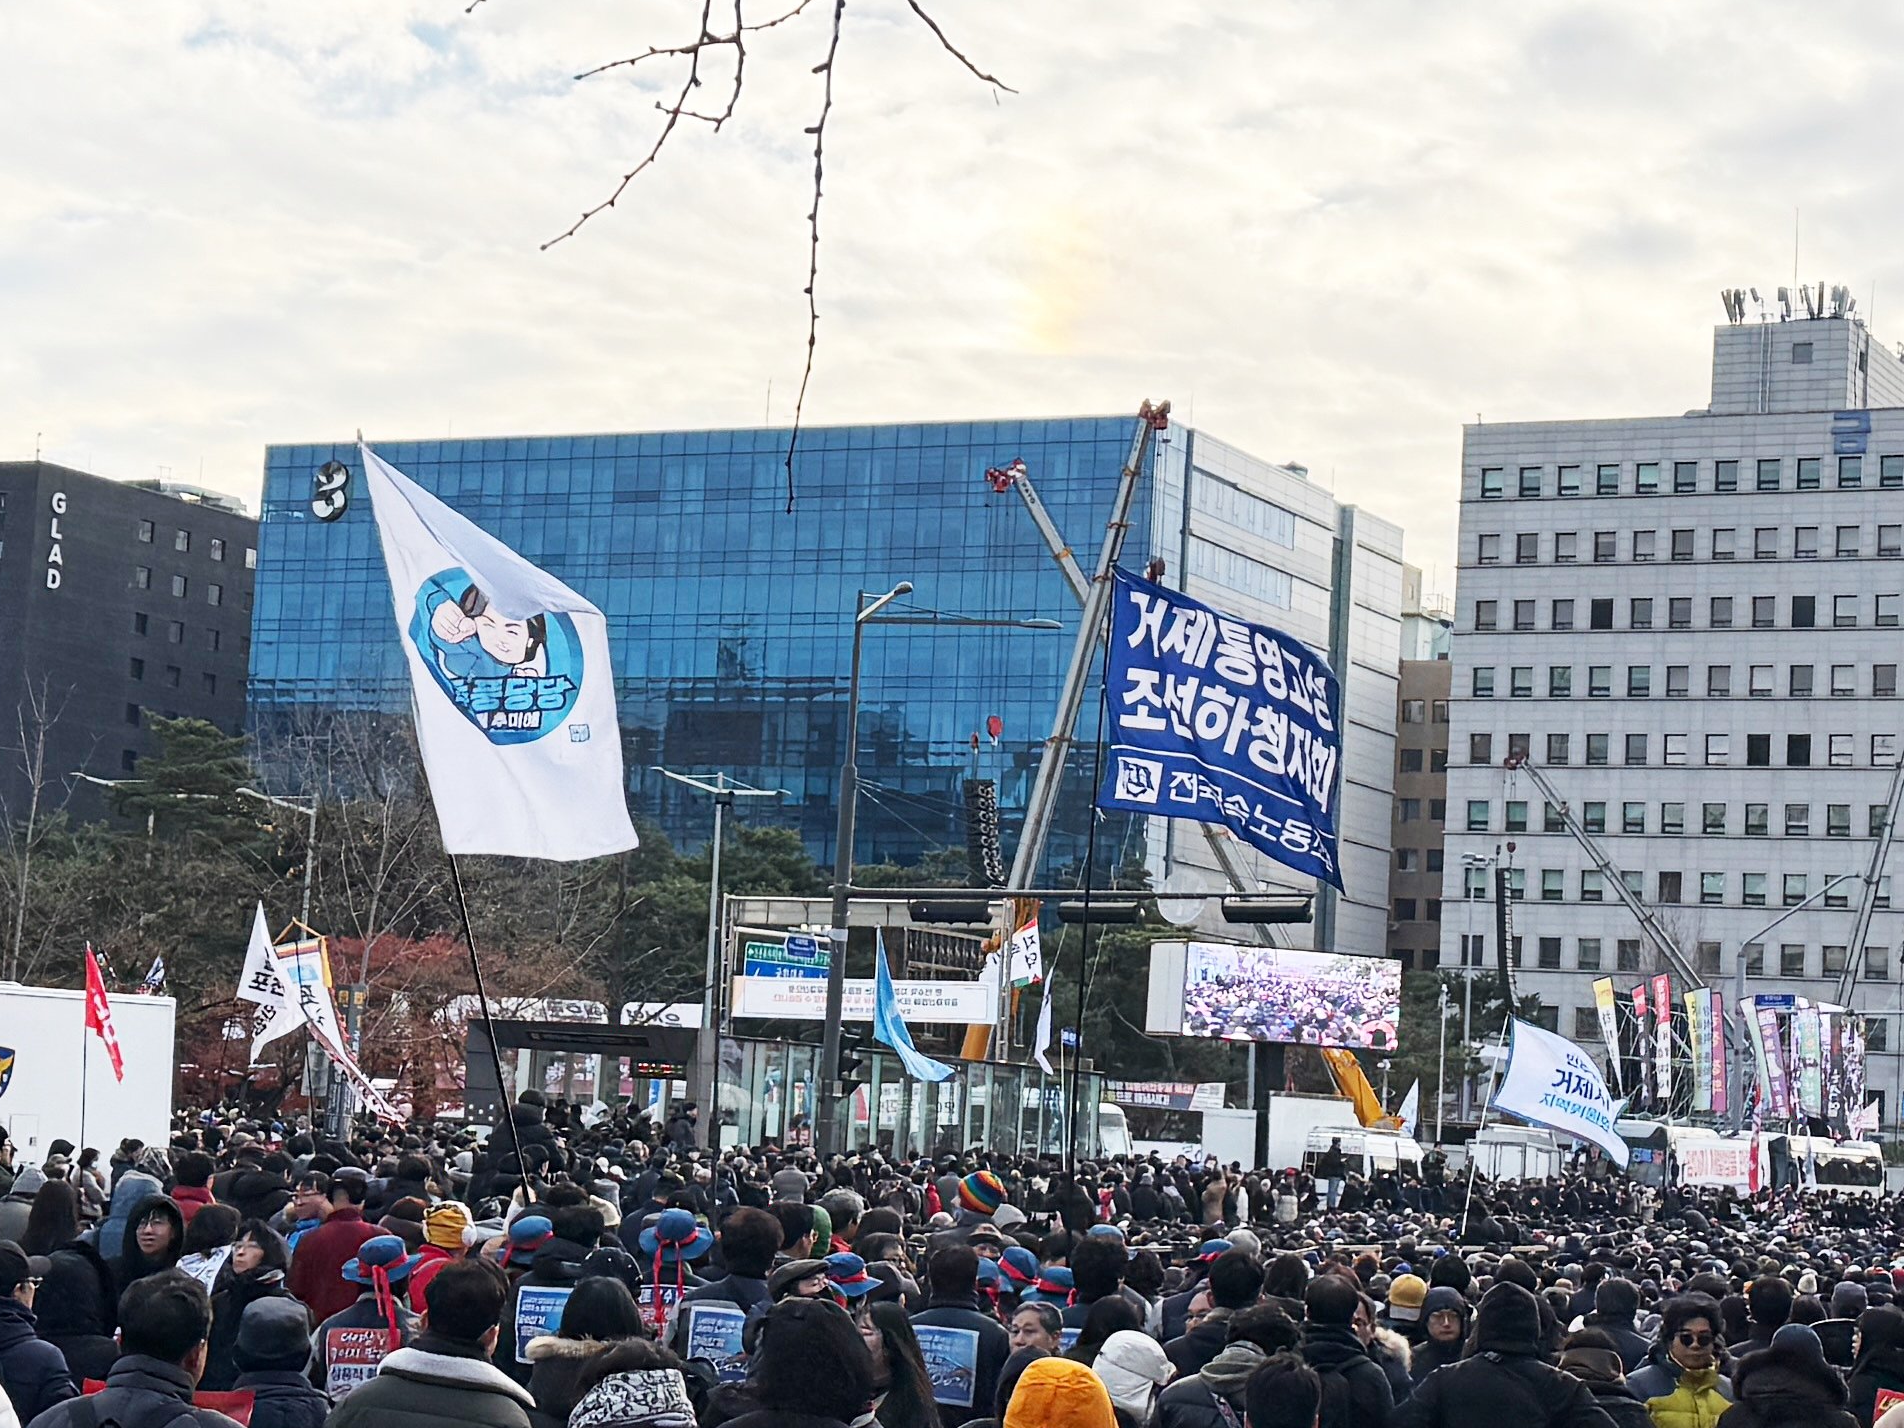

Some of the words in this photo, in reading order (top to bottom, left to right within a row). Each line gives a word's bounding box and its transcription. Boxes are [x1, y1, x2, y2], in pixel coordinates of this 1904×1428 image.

[47, 491, 67, 589] GLAD
[1127, 590, 1334, 732] 거제통영고성
[1119, 667, 1337, 814] 조선하청지회
